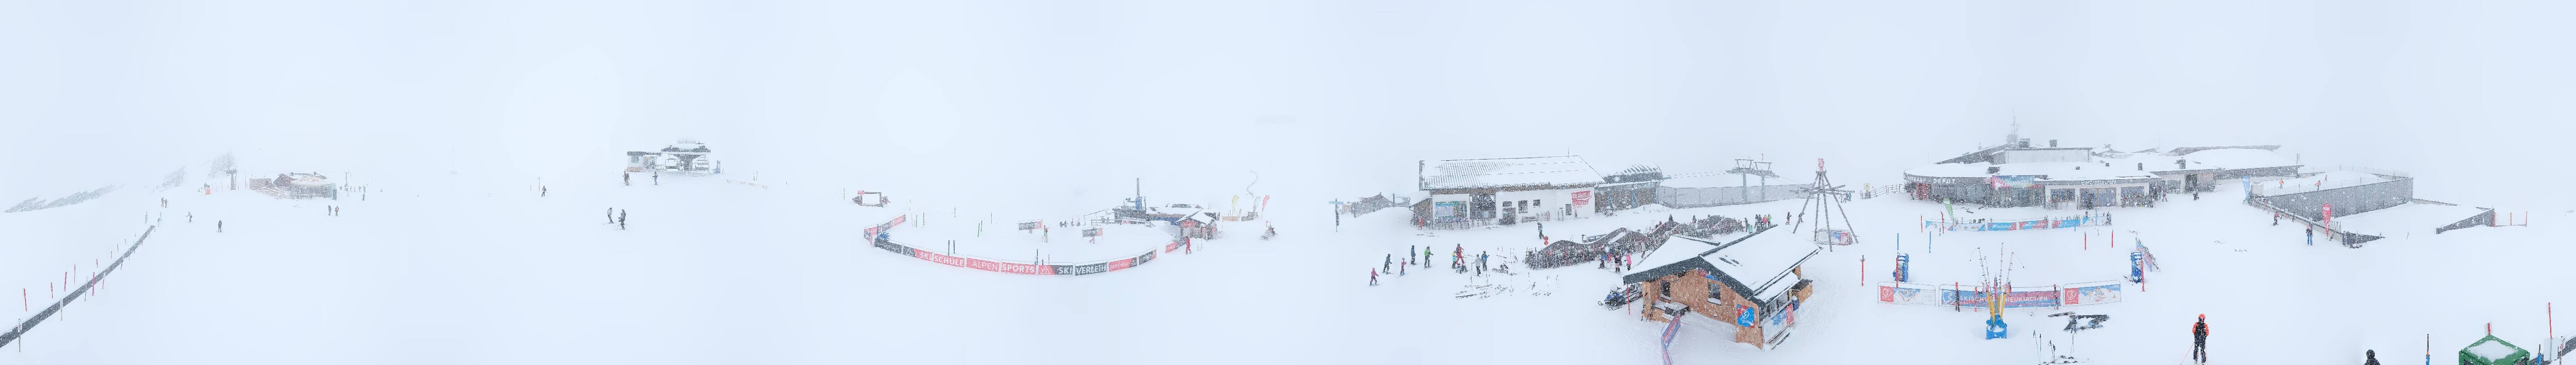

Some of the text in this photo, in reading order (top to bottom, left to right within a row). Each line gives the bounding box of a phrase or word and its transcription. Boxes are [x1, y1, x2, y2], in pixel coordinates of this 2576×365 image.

[920, 251, 932, 261] SKI
[935, 255, 964, 266] SCHULE
[972, 261, 998, 271] ALPEN
[1003, 264, 1035, 273] SPORTS
[1075, 264, 1106, 274] VERLEIH
